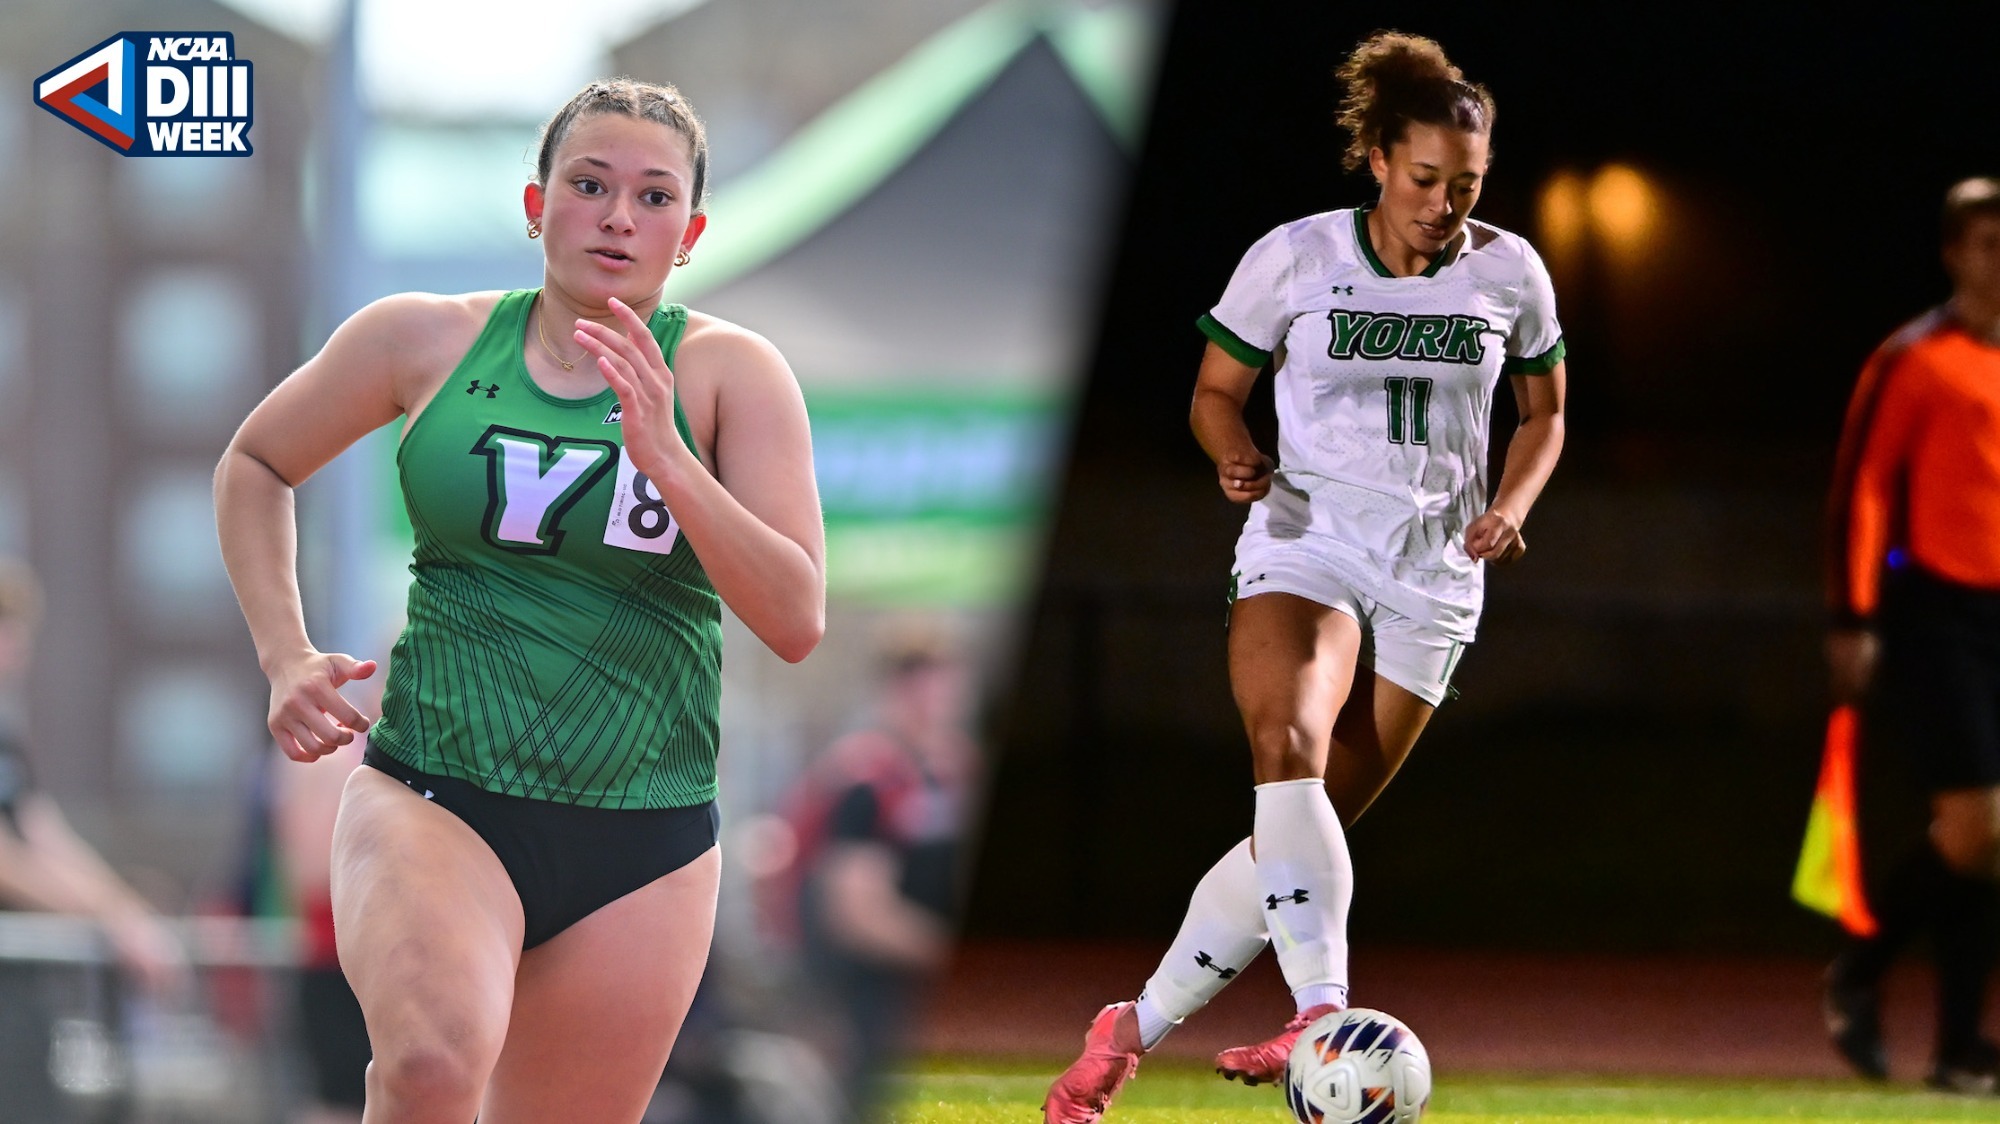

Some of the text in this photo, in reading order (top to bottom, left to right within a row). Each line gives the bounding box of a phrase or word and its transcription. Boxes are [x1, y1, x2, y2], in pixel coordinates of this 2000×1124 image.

[1328, 309, 1489, 365] YORK
[1385, 377, 1433, 445] 11
[469, 424, 619, 556] Y
[628, 470, 669, 539] 8
